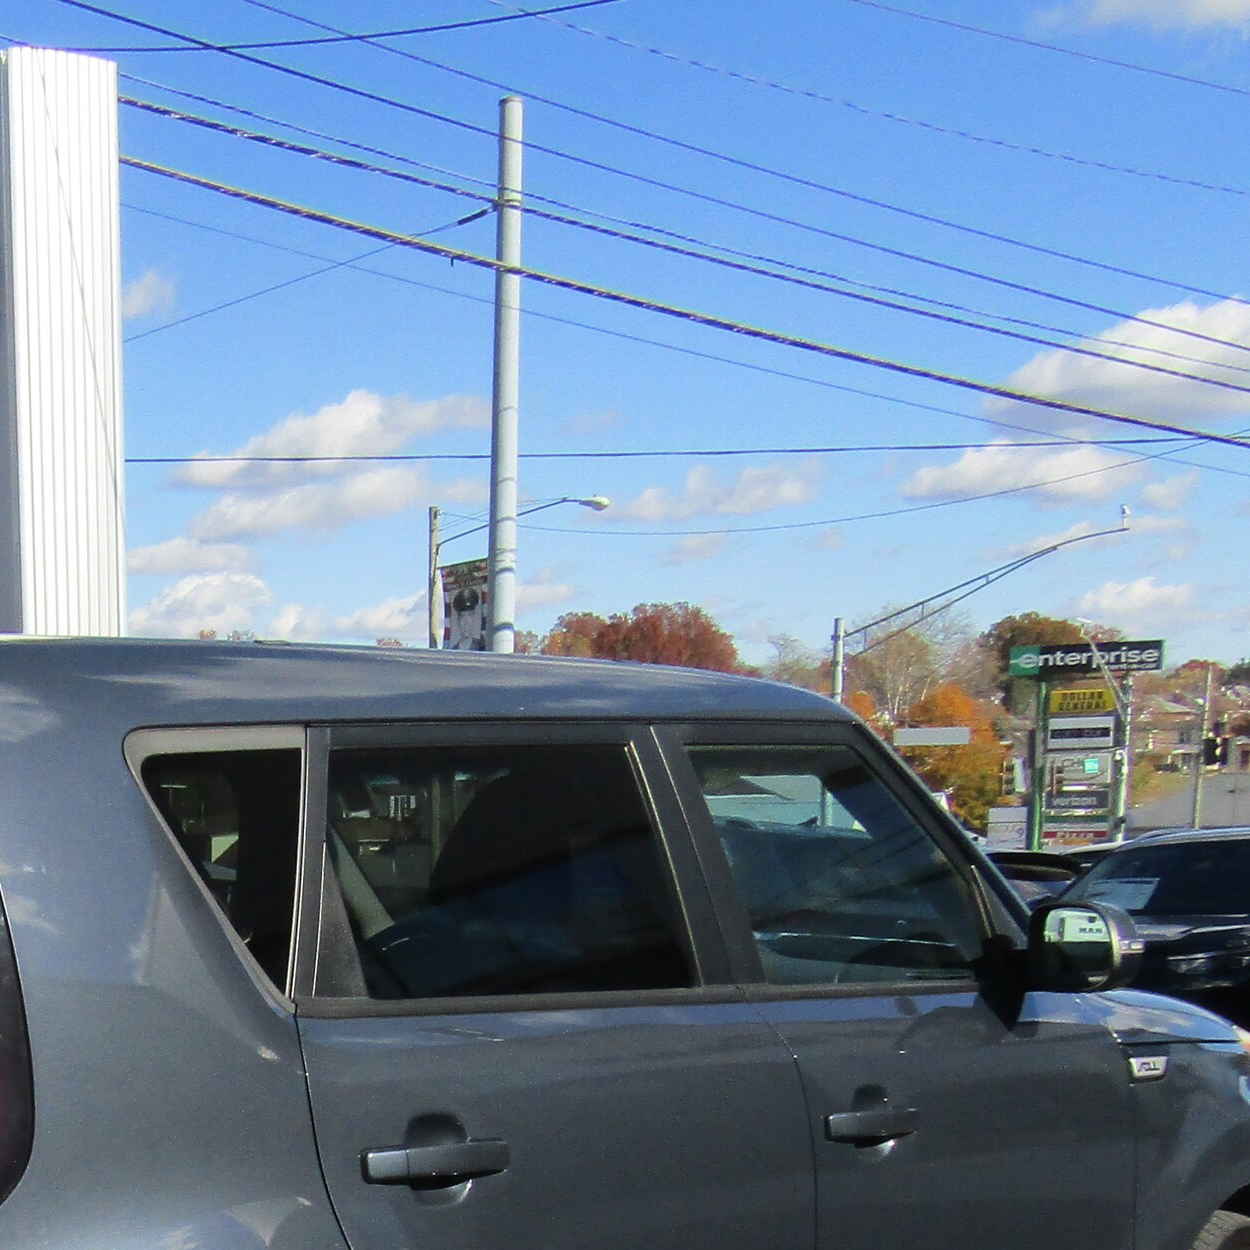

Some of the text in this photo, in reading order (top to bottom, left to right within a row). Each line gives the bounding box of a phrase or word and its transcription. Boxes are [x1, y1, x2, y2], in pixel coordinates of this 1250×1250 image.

[1018, 646, 1159, 669] enterprise
[1061, 691, 1103, 701] DOLLAR
[1058, 700, 1106, 711] GENERAL
